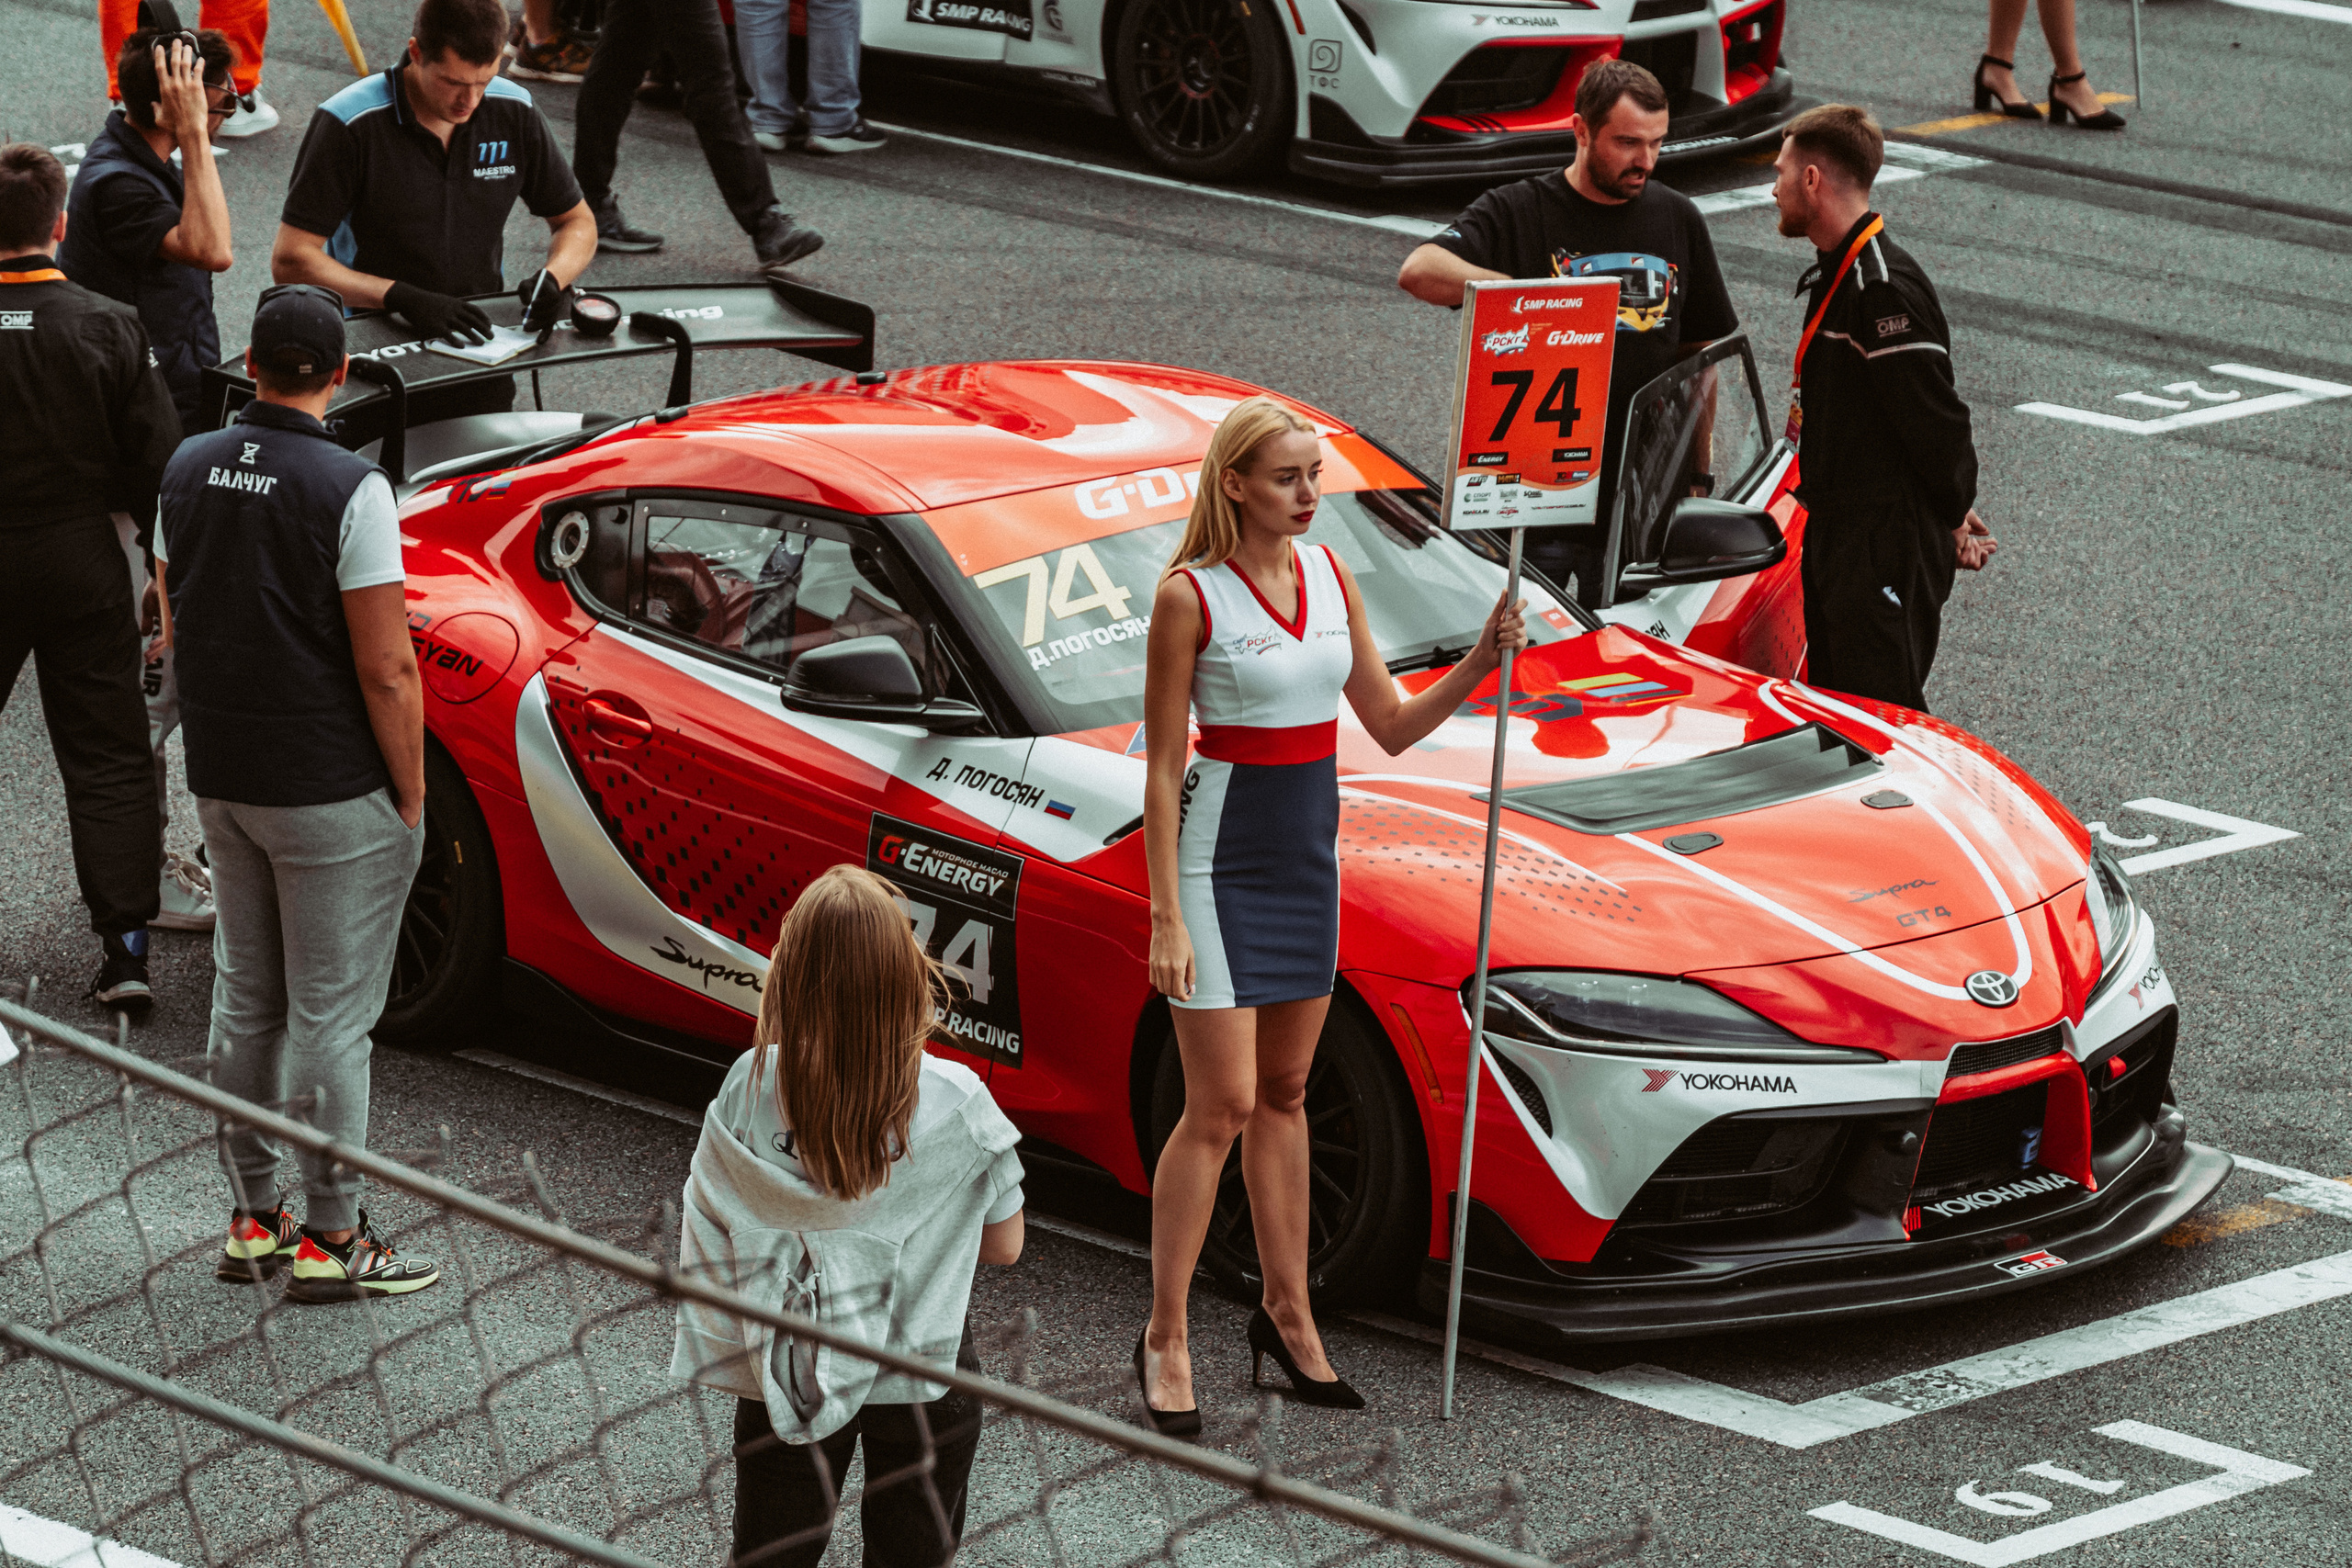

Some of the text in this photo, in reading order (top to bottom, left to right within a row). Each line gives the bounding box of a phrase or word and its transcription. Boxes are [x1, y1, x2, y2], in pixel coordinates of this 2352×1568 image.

[936, 3, 978, 20] SMP
[1495, 16, 1560, 28] YOKOHAMA
[473, 165, 515, 177] MAESTRO
[1523, 298, 1584, 310] SMP RACING
[0, 313, 33, 327] OMP
[1877, 317, 1910, 334] OMP
[1488, 367, 1581, 441] 74
[207, 466, 277, 495] БАЛЧУГ
[973, 543, 1133, 649] 74
[954, 764, 1045, 808] ПОГОСЯН
[932, 849, 1009, 879] МОТОРНОЕ МАСЛО
[1848, 879, 1939, 903] Supra
[1896, 906, 1951, 927] GT4
[893, 895, 994, 1004] 74
[650, 936, 763, 993] Supra
[947, 1011, 1020, 1054] RACING
[1680, 1073, 1798, 1094] YOKOHAMA
[1923, 1172, 2079, 1217] YOKOHAMA
[2009, 1256, 2060, 1275] GR
